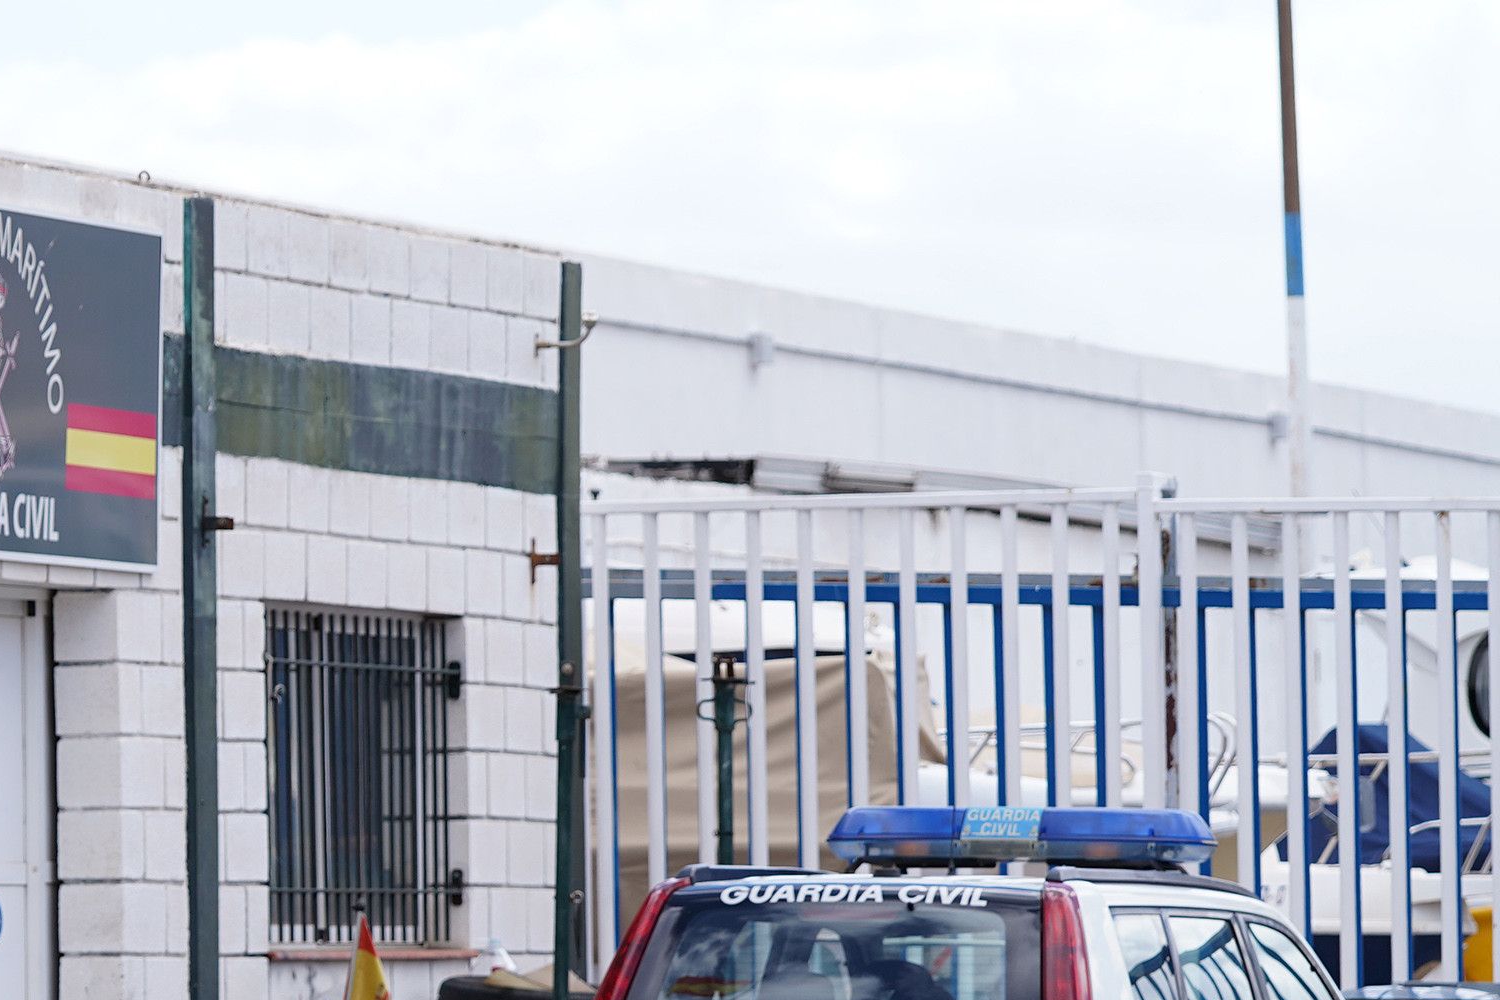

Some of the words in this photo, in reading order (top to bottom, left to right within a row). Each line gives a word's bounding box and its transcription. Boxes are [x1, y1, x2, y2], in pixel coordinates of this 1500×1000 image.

[13, 493, 60, 542] CIVIL
[966, 808, 1041, 821] GUARDIA
[981, 822, 1020, 836] CIVIL
[720, 884, 884, 905] GUARDIA
[898, 886, 988, 907] CIVIL
